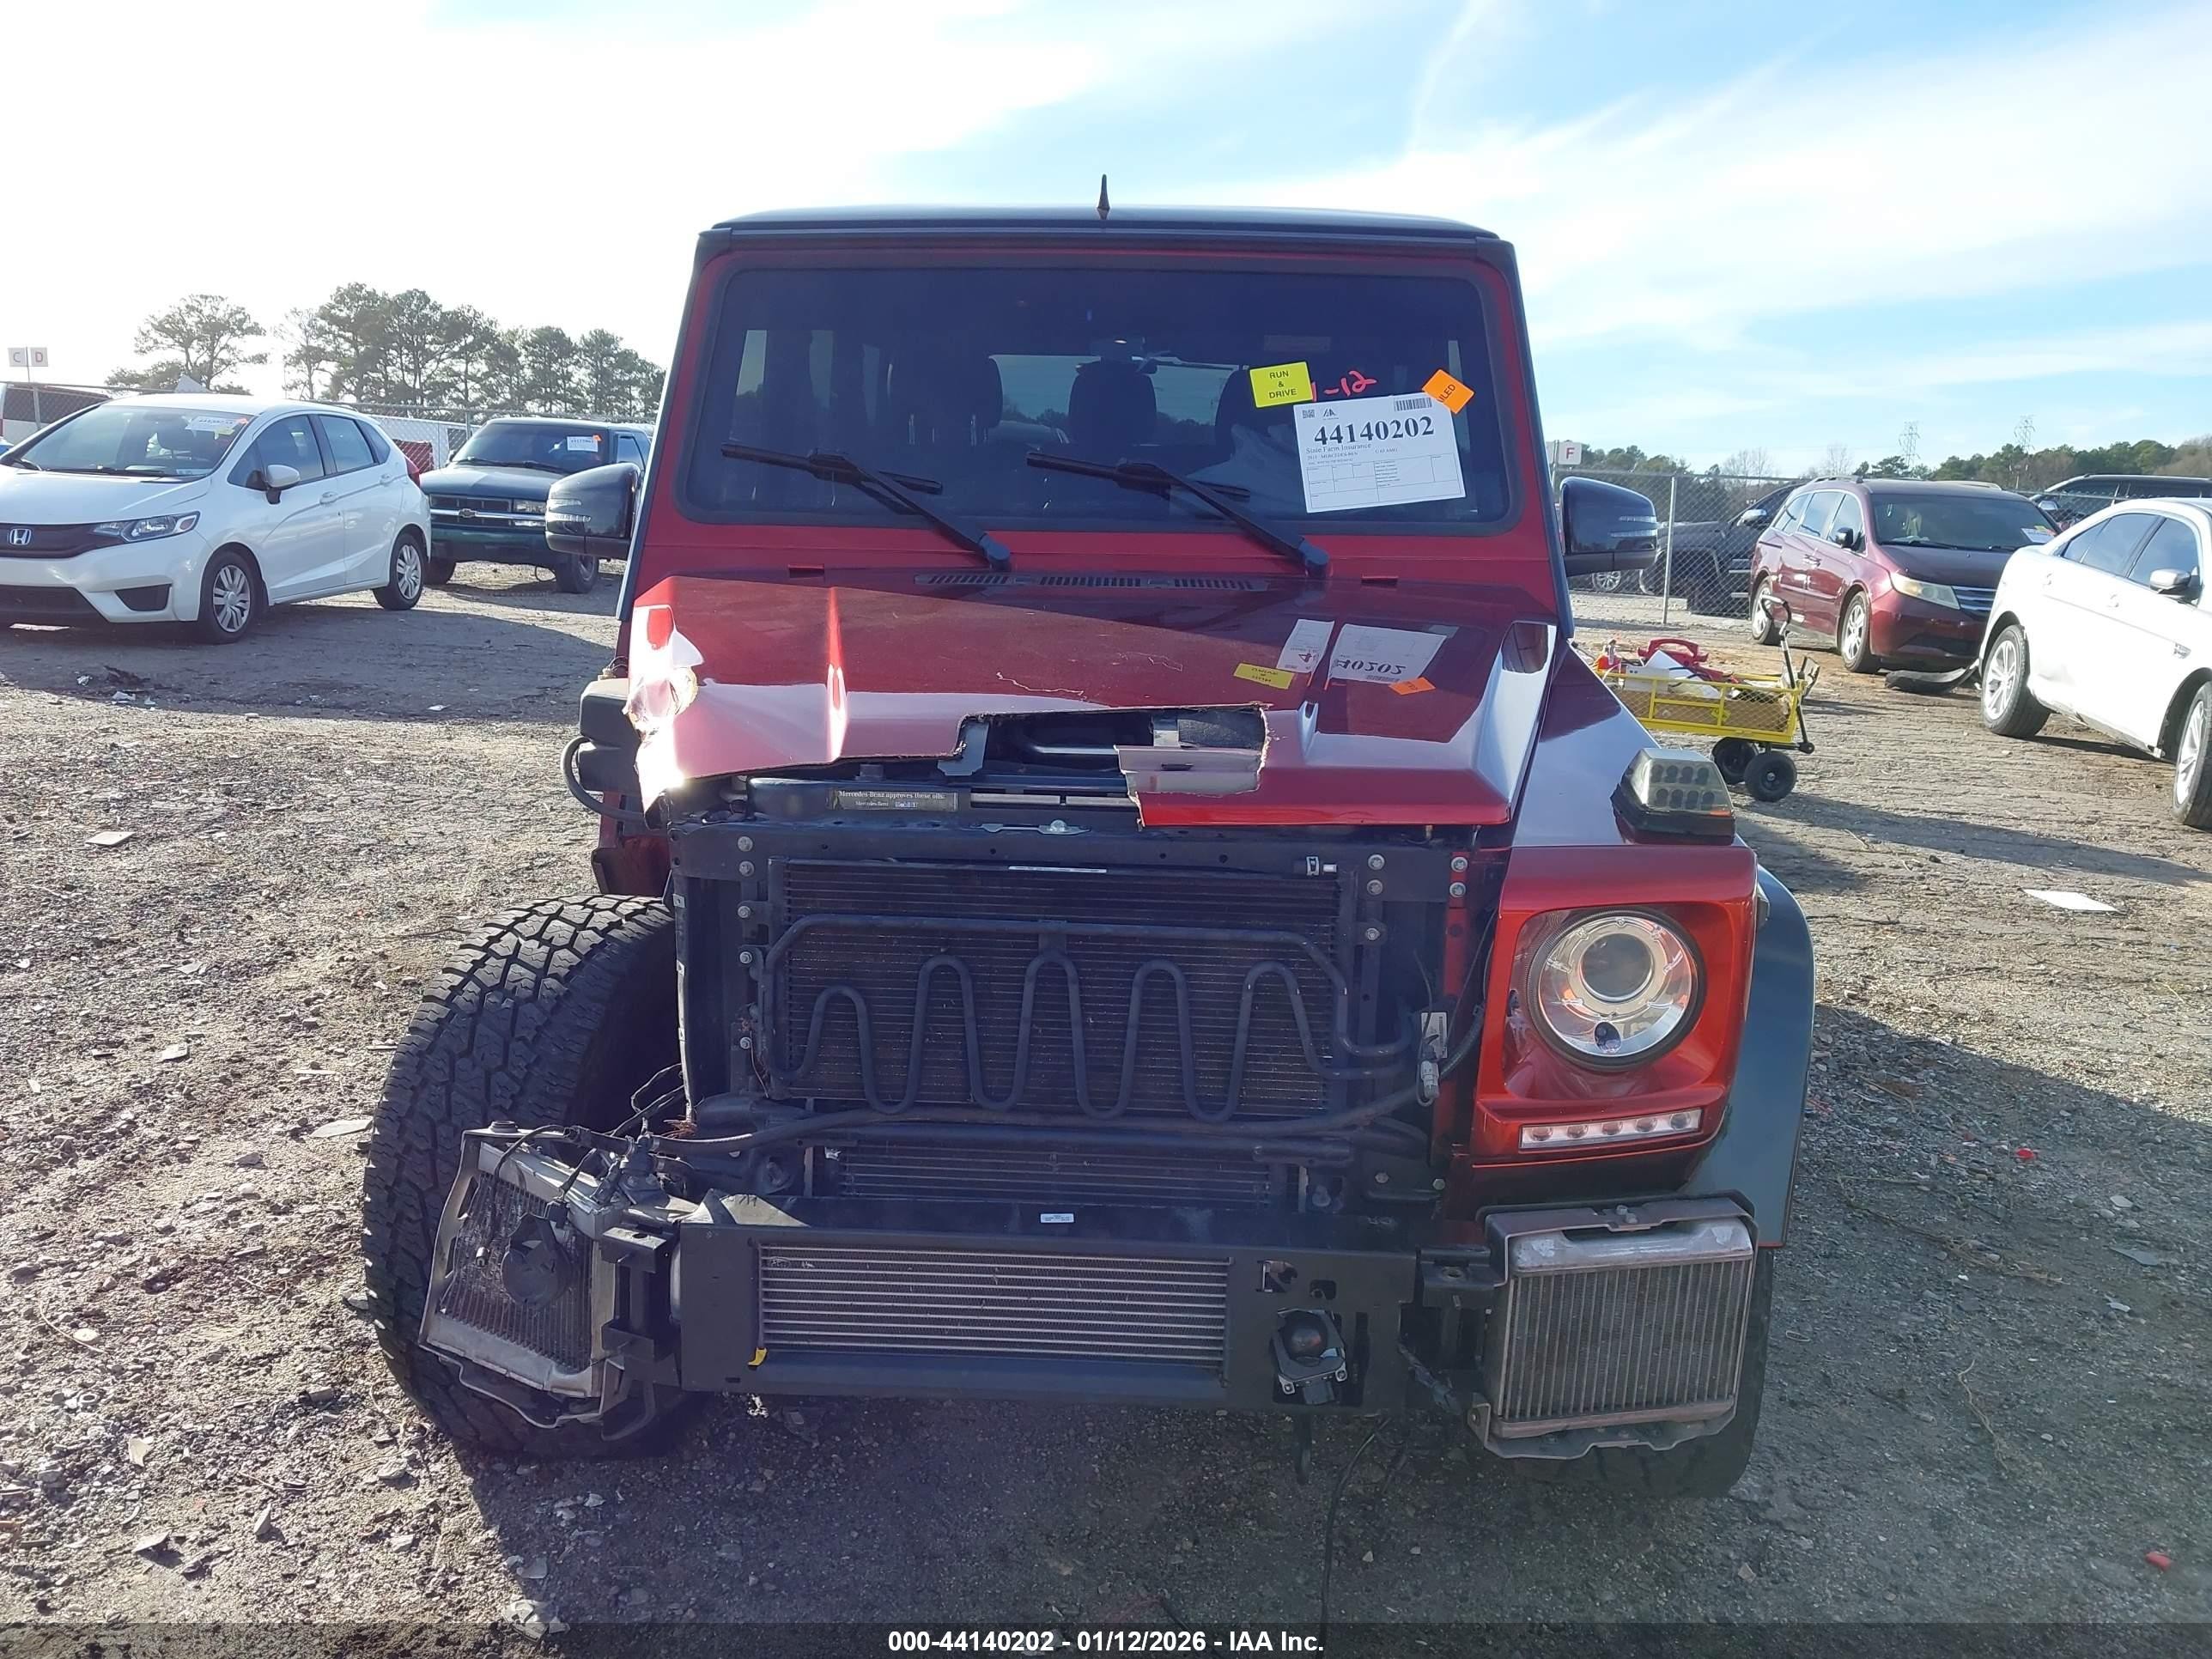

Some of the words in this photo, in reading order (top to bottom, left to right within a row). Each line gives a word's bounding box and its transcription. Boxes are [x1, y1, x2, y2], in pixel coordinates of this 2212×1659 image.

[13, 352, 21, 362] C
[35, 352, 43, 362] D
[1269, 370, 1289, 380] RUN
[1269, 387, 1297, 399] DRIVE
[1315, 416, 1435, 446] 44140202
[1566, 447, 1575, 459] F
